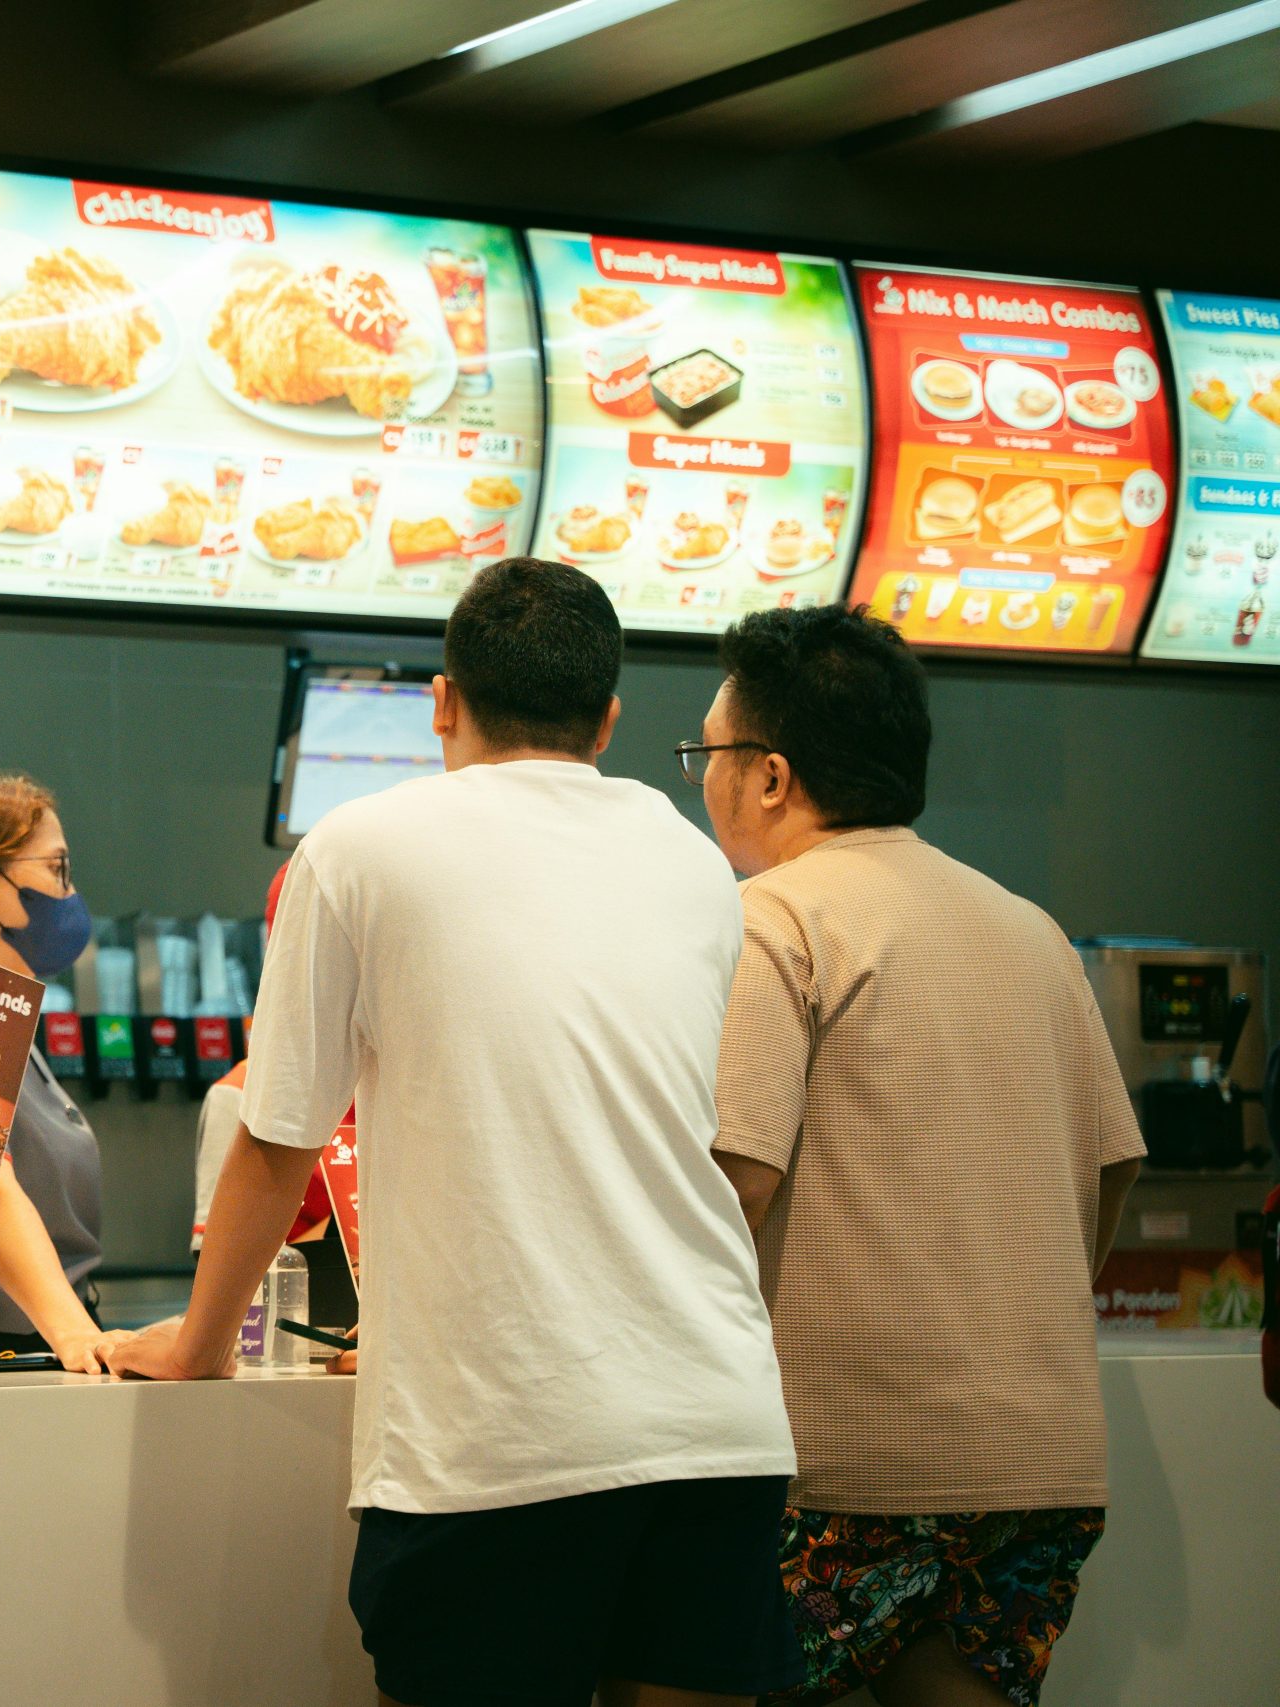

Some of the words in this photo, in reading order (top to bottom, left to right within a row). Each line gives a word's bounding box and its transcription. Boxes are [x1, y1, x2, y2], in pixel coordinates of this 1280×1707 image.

[83, 190, 268, 244] Chickenjoy
[600, 248, 665, 281] Family
[665, 252, 721, 284] Super
[907, 288, 952, 316] Mix
[953, 292, 975, 319] &
[977, 294, 1049, 325] Match
[1050, 301, 1142, 333] Combos
[1186, 302, 1242, 327] Sweet
